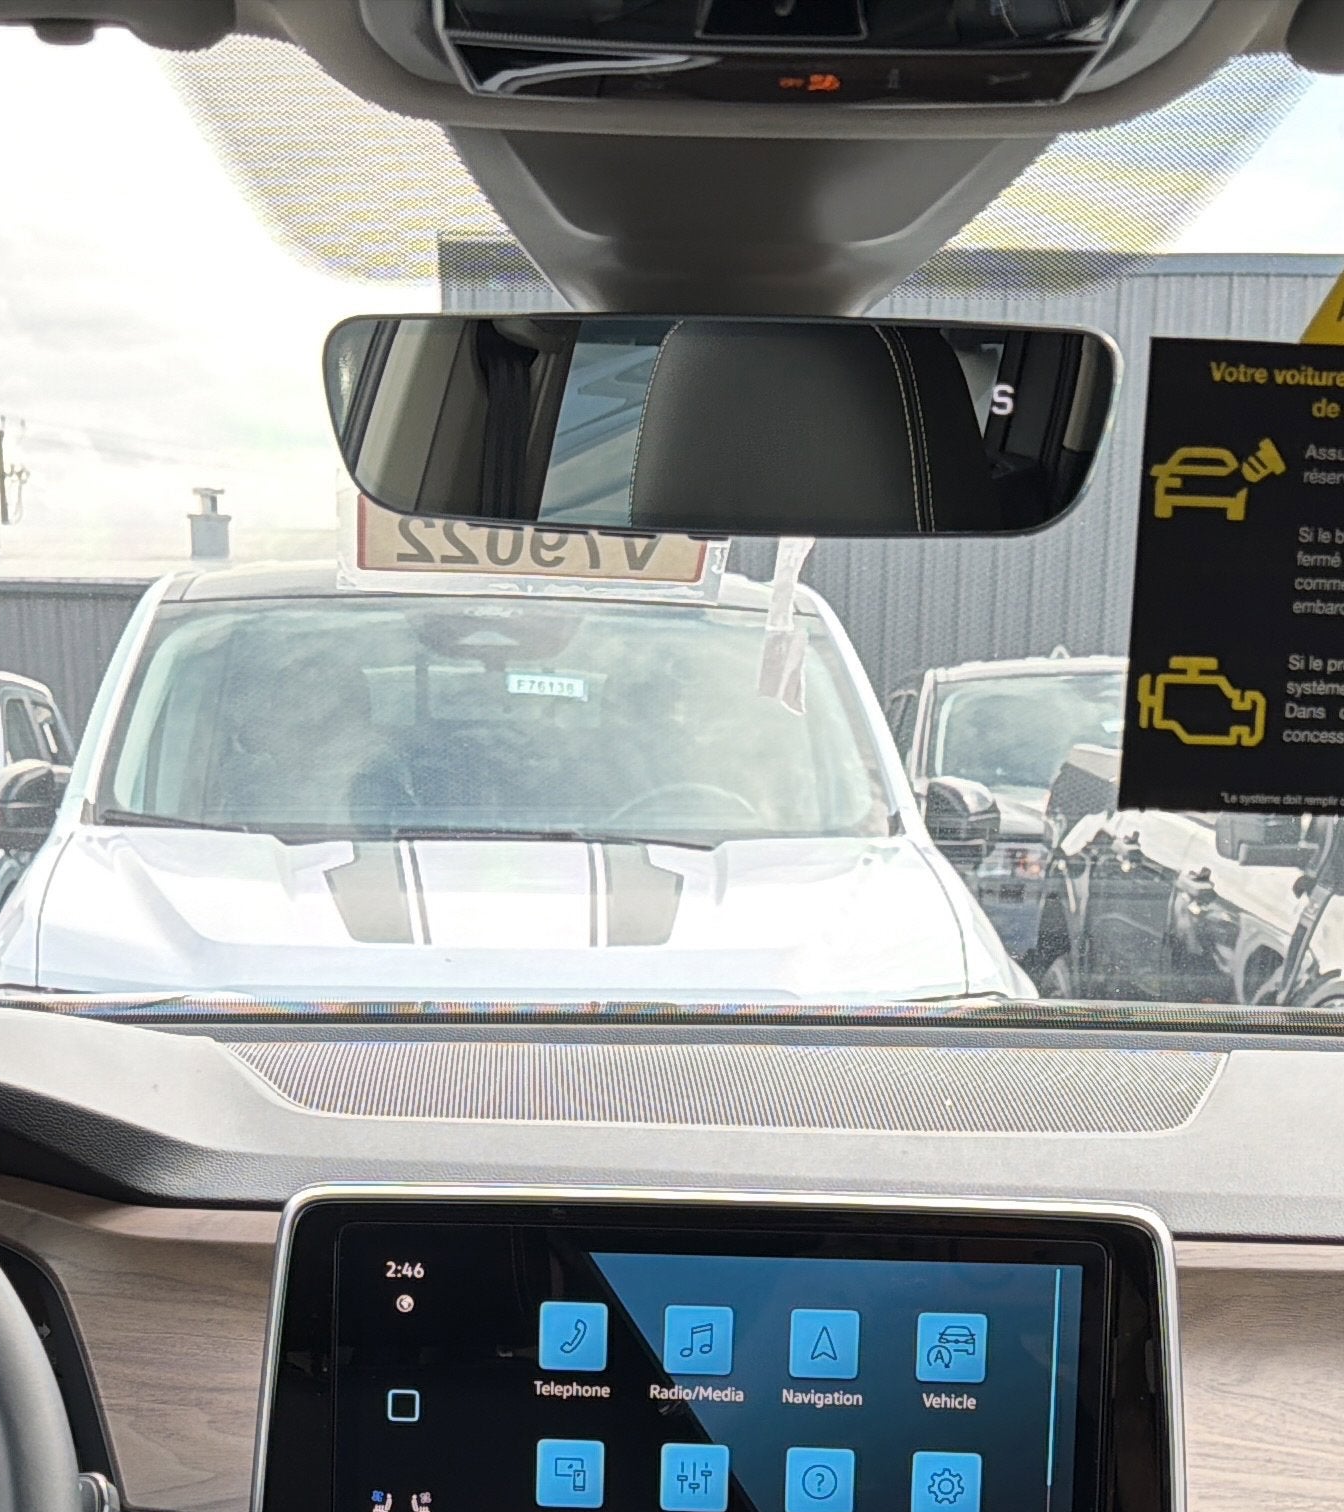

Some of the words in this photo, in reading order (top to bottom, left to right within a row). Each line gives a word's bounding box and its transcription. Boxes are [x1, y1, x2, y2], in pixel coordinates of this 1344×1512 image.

[1211, 362, 1268, 384] Votre
[992, 384, 1015, 415] S
[1312, 398, 1340, 418] de
[1299, 526, 1314, 543] Si
[1318, 528, 1332, 544] le
[1297, 552, 1342, 568] fermé
[1289, 654, 1305, 671] Si
[1309, 656, 1323, 670] le
[1285, 701, 1326, 719] Dans
[385, 1261, 425, 1279] 2:46
[534, 1380, 610, 1399] Telephone
[649, 1383, 744, 1403] Radio/Media
[782, 1388, 863, 1409] Navigation
[922, 1392, 977, 1410] Vehicle
